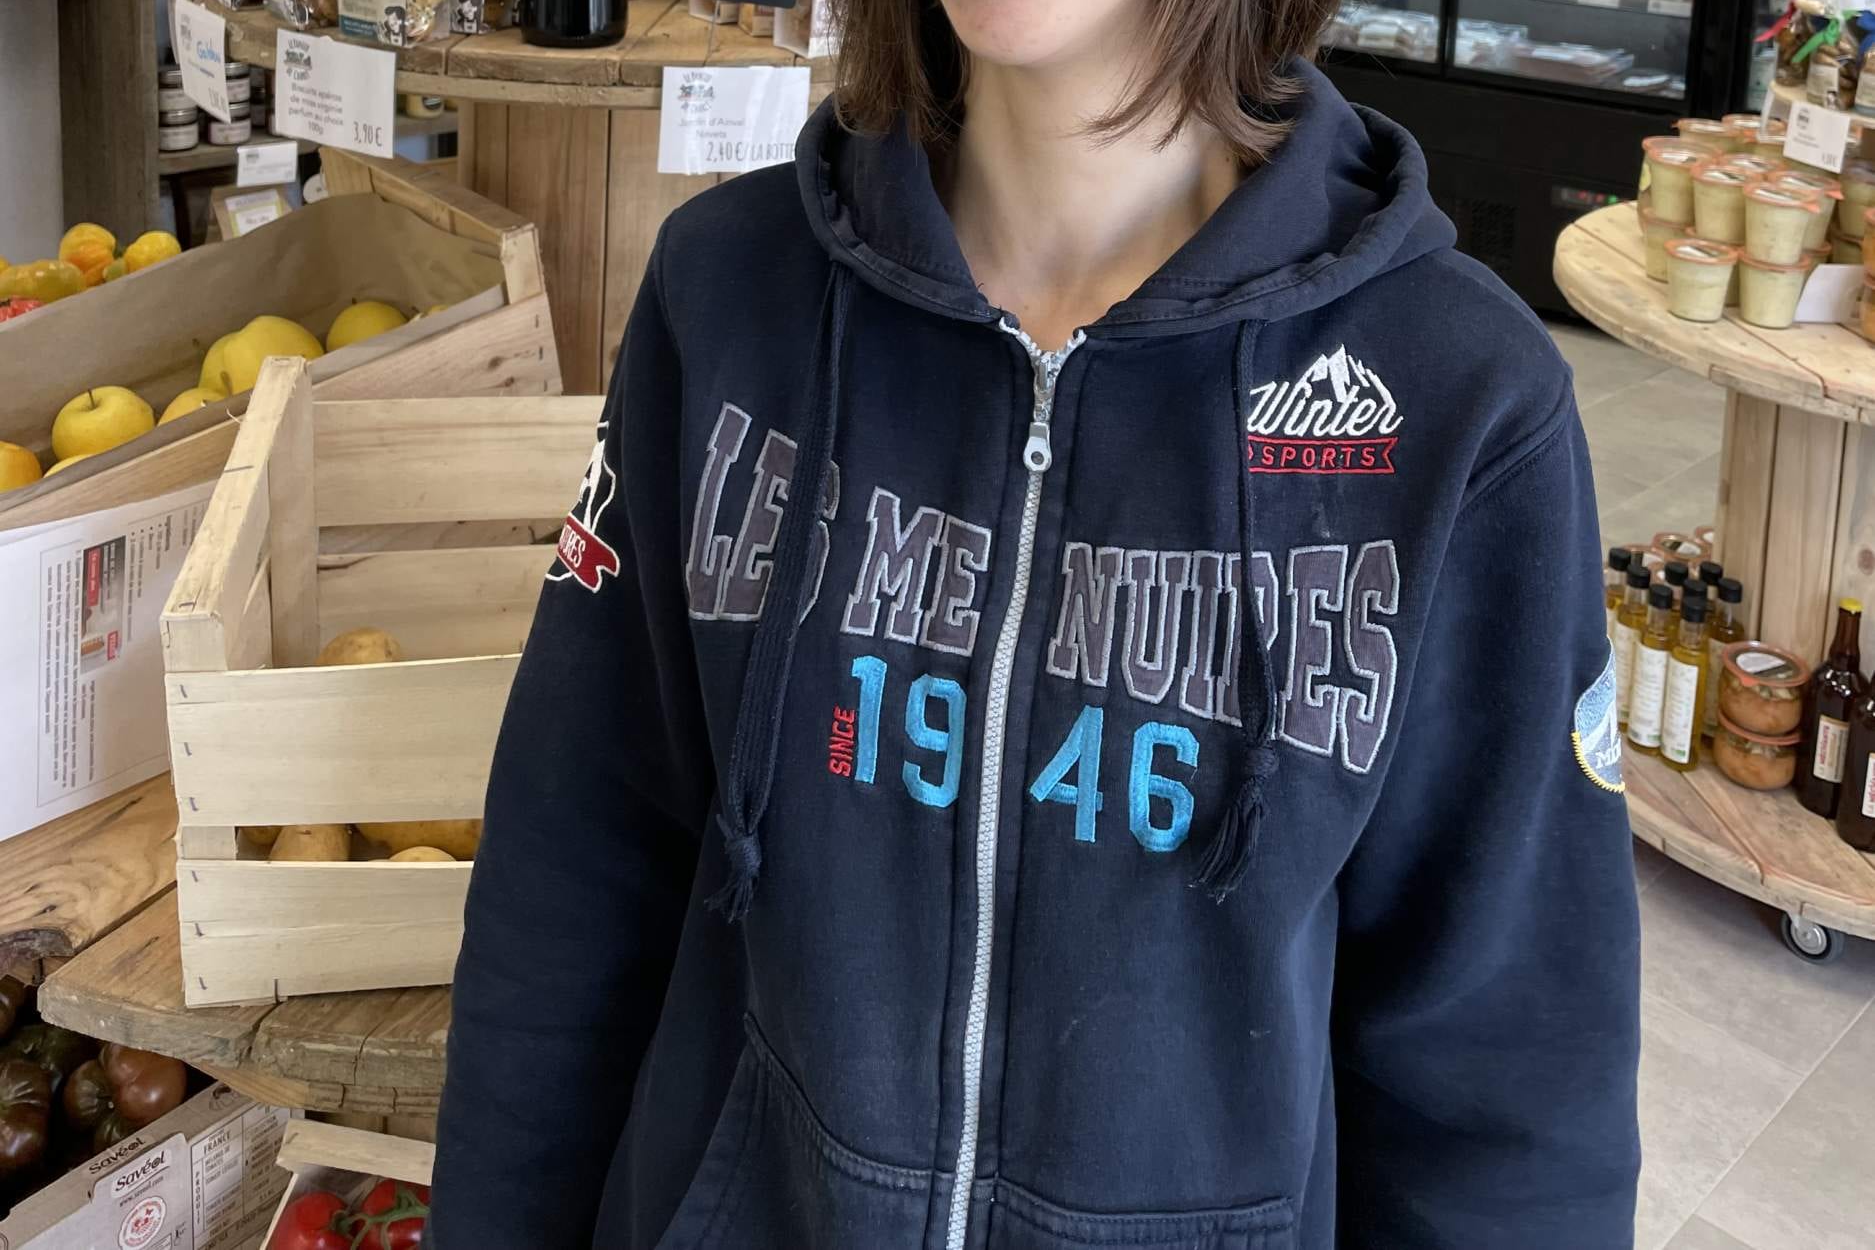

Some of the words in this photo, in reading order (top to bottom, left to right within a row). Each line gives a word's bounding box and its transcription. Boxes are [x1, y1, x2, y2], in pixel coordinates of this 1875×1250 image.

[1261, 445, 1377, 468] SPORTS
[829, 704, 857, 778] SINCE
[88, 1136, 146, 1175] Savéol
[203, 1130, 231, 1156] FRANCE
[115, 1150, 165, 1192] Savéol
